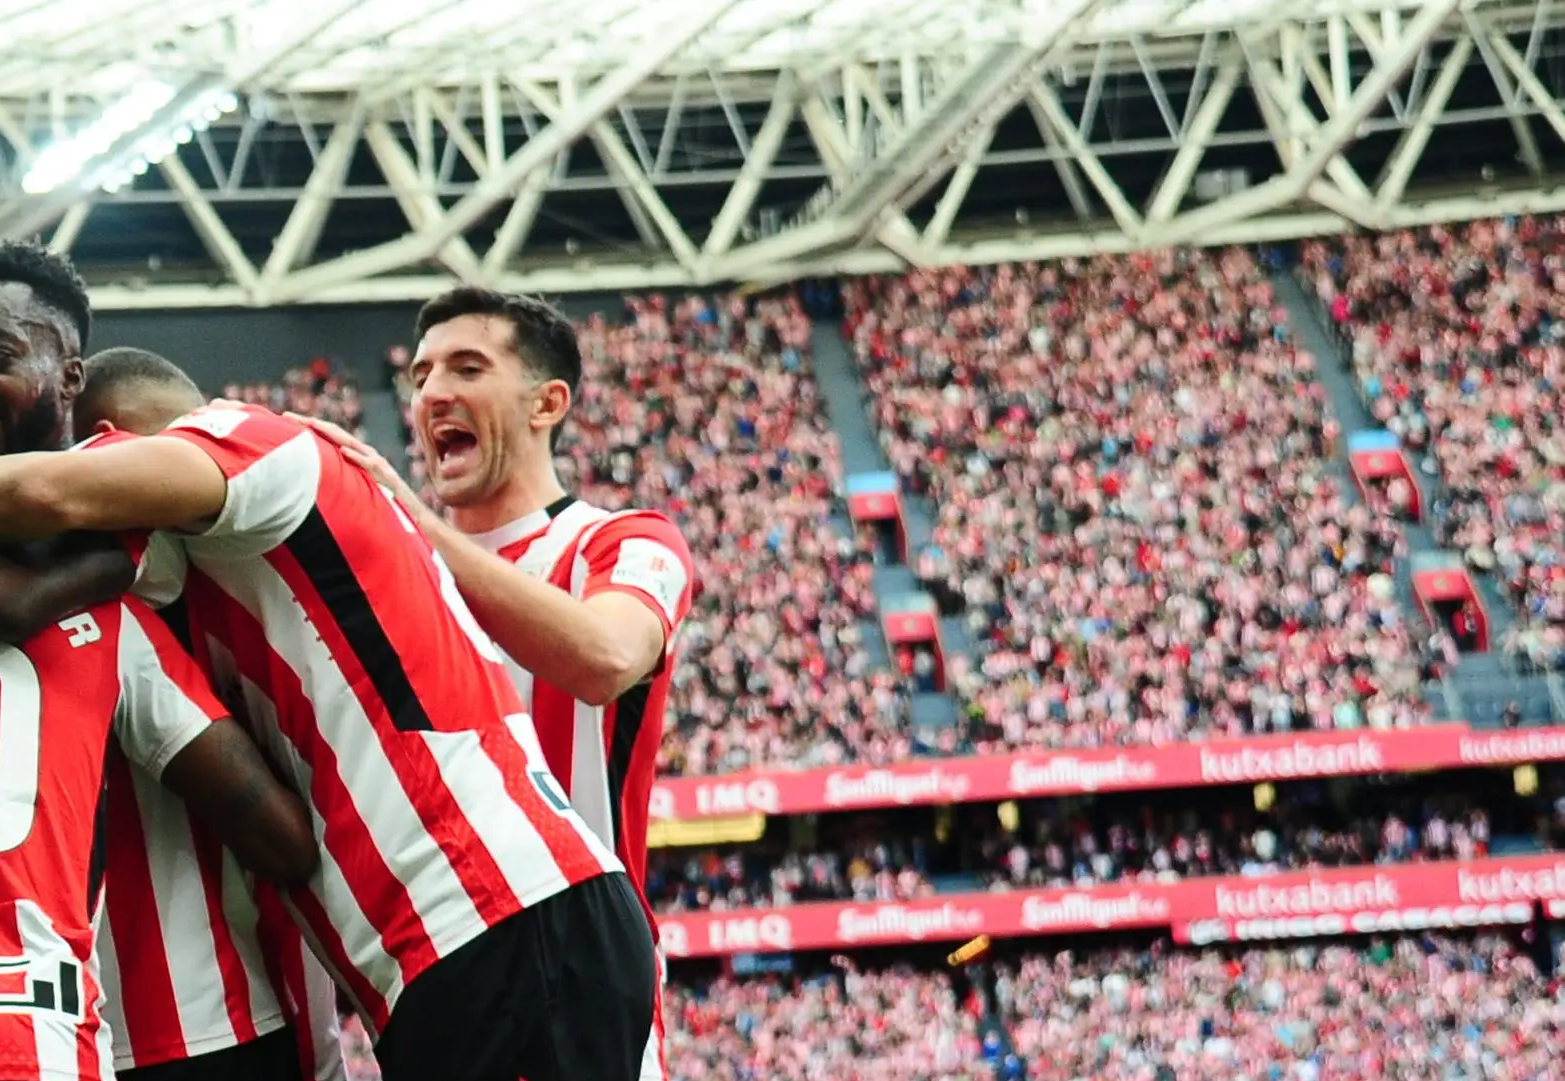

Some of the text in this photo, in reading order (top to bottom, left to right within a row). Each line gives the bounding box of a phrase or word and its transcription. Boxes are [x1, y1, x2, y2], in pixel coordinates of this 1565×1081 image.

[1201, 736, 1384, 781] kutxabank
[1458, 731, 1565, 764] kutxaba
[695, 778, 778, 814] IMQ
[1215, 872, 1398, 918] kutxabank
[708, 914, 791, 949] IMQ
